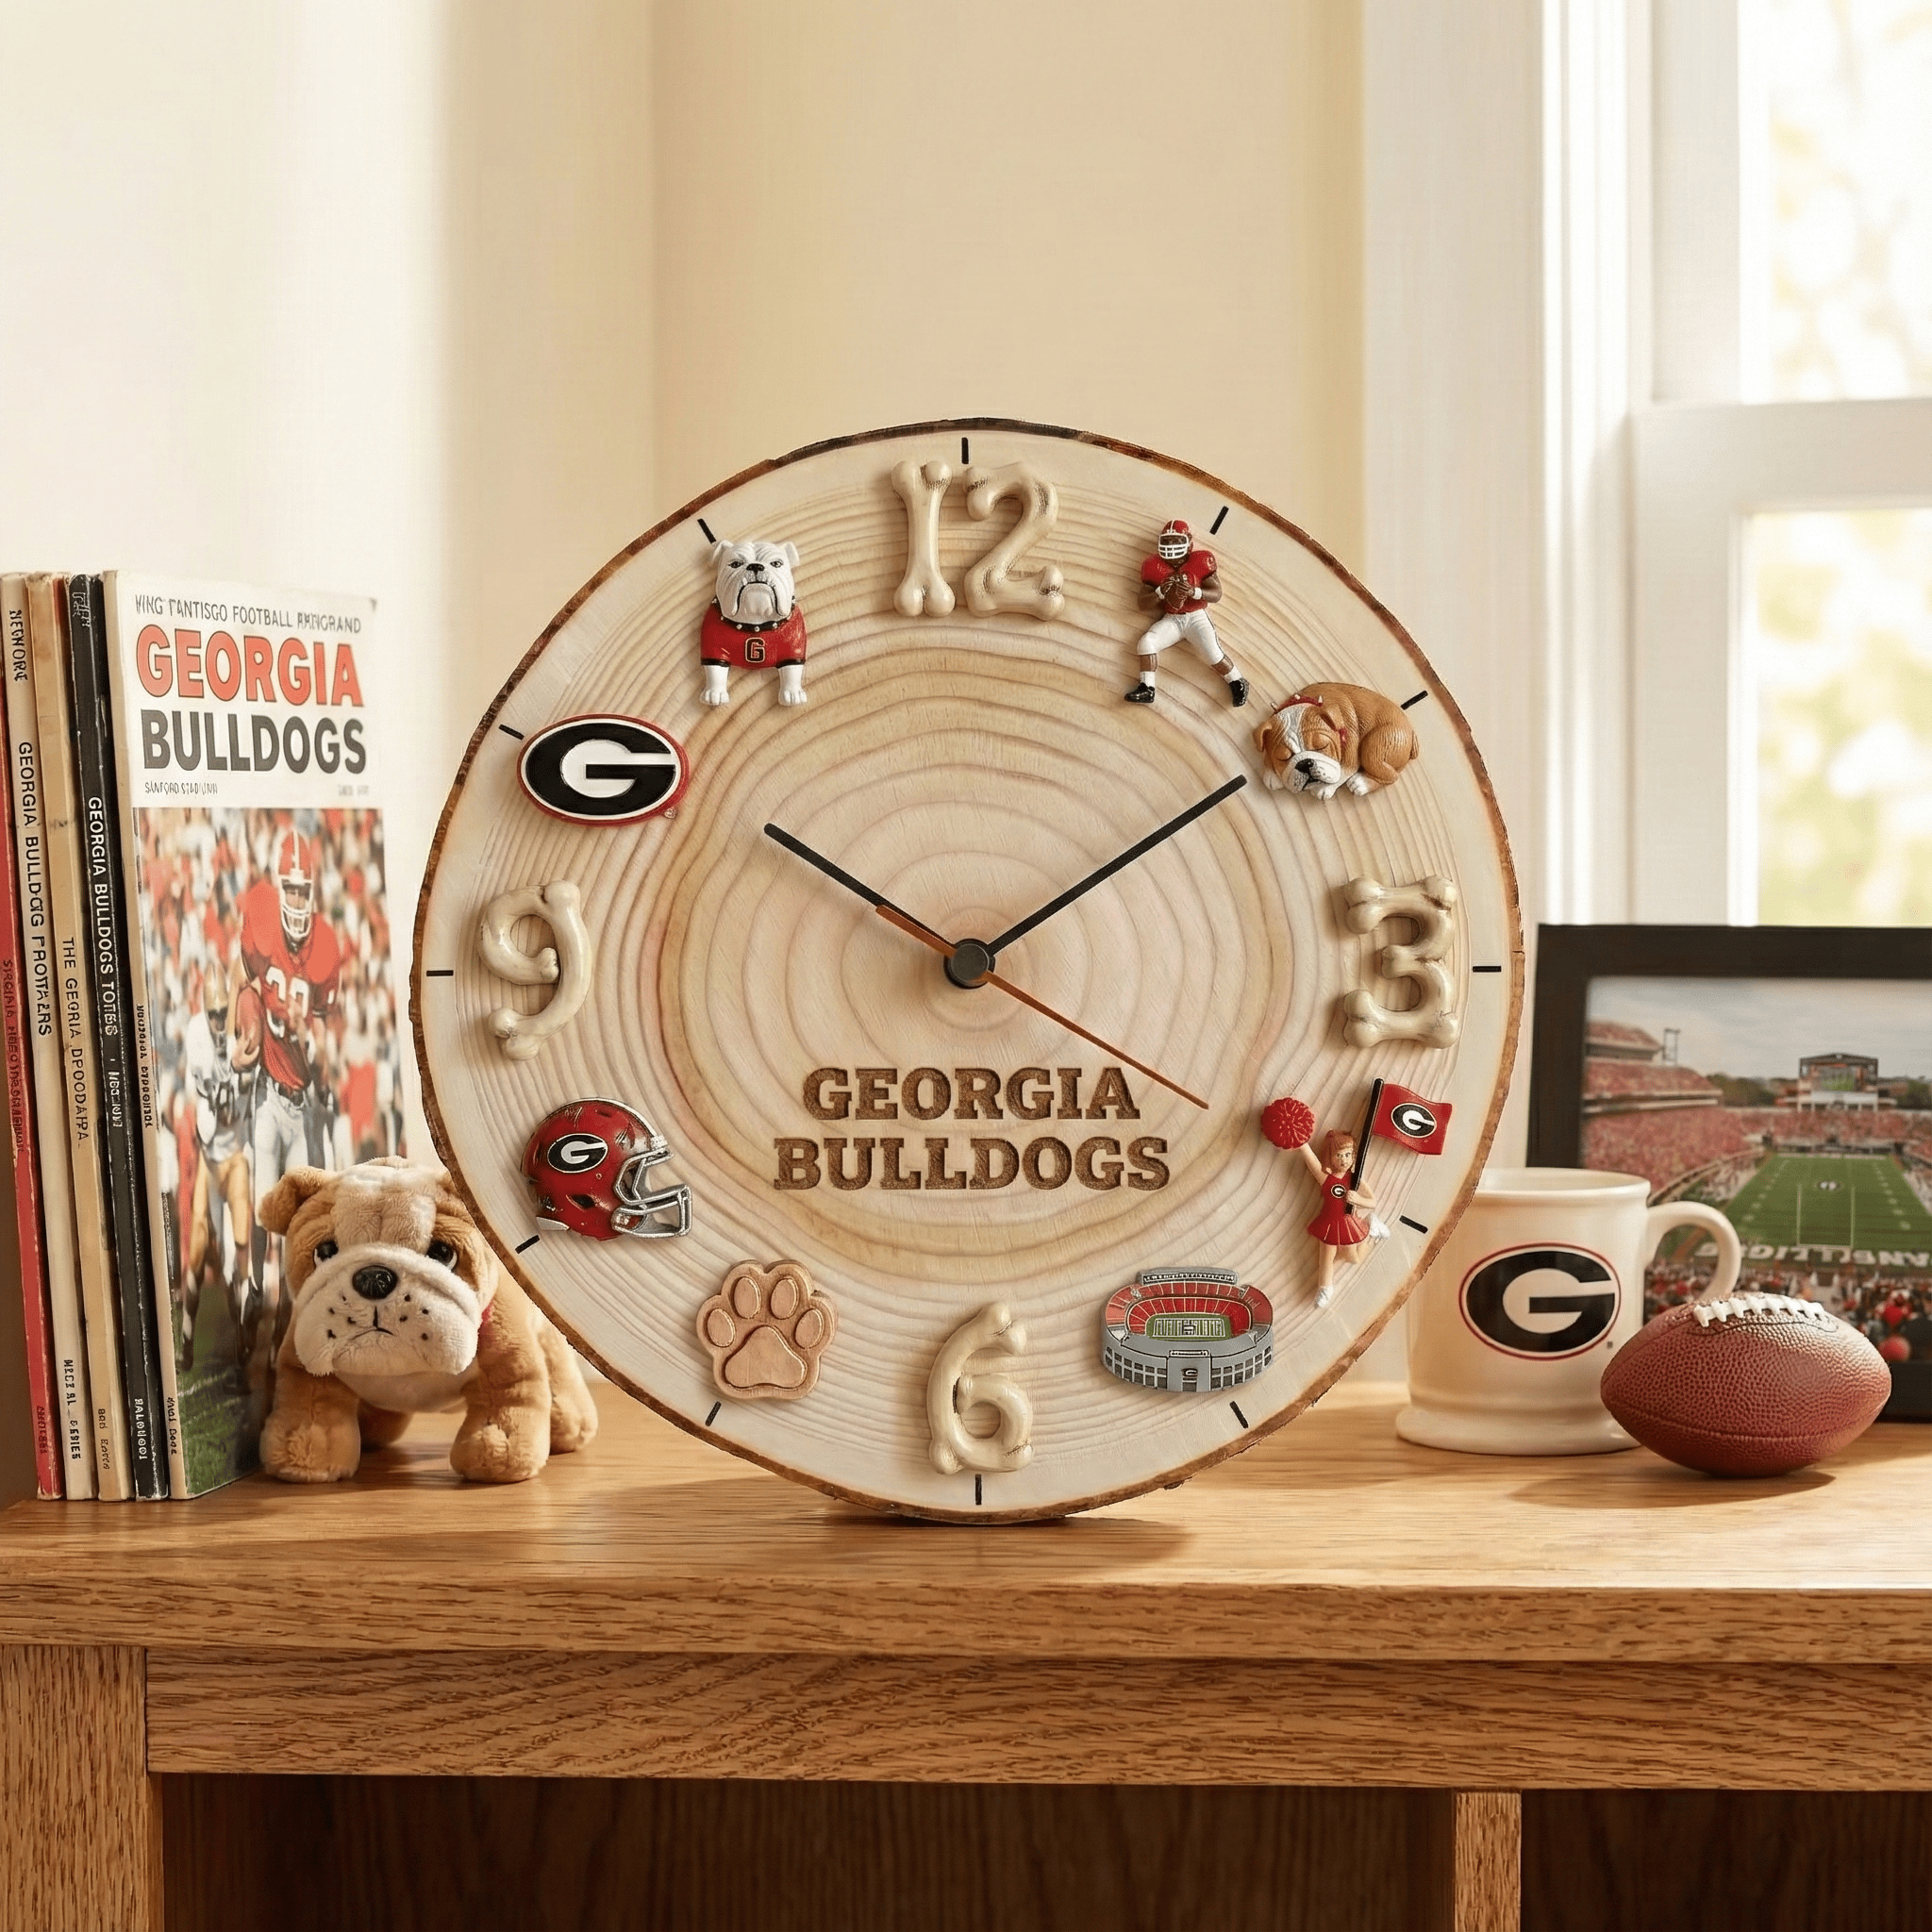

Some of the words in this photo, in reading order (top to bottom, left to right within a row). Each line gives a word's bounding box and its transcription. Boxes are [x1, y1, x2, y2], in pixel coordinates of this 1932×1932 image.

[891, 459, 1065, 622] 12
[232, 605, 293, 627] FOOTBALL
[745, 637, 766, 662] G
[136, 624, 364, 708] GEORGIA
[141, 708, 367, 774] BULLDOGS
[525, 722, 676, 817] G
[19, 742, 38, 826] GEORGIA
[89, 796, 107, 875] GEORGIA
[62, 937, 75, 969] THE
[94, 884, 113, 974] BULLDOGS
[1342, 874, 1459, 1049] 3
[479, 880, 592, 1060] 9
[802, 1067, 1141, 1120] GEORGIA
[1392, 1103, 1437, 1138] G
[548, 1134, 608, 1173] G
[774, 1136, 1170, 1191] BULLDOGS
[1466, 1251, 1615, 1353] G
[927, 1303, 1034, 1474] 6
